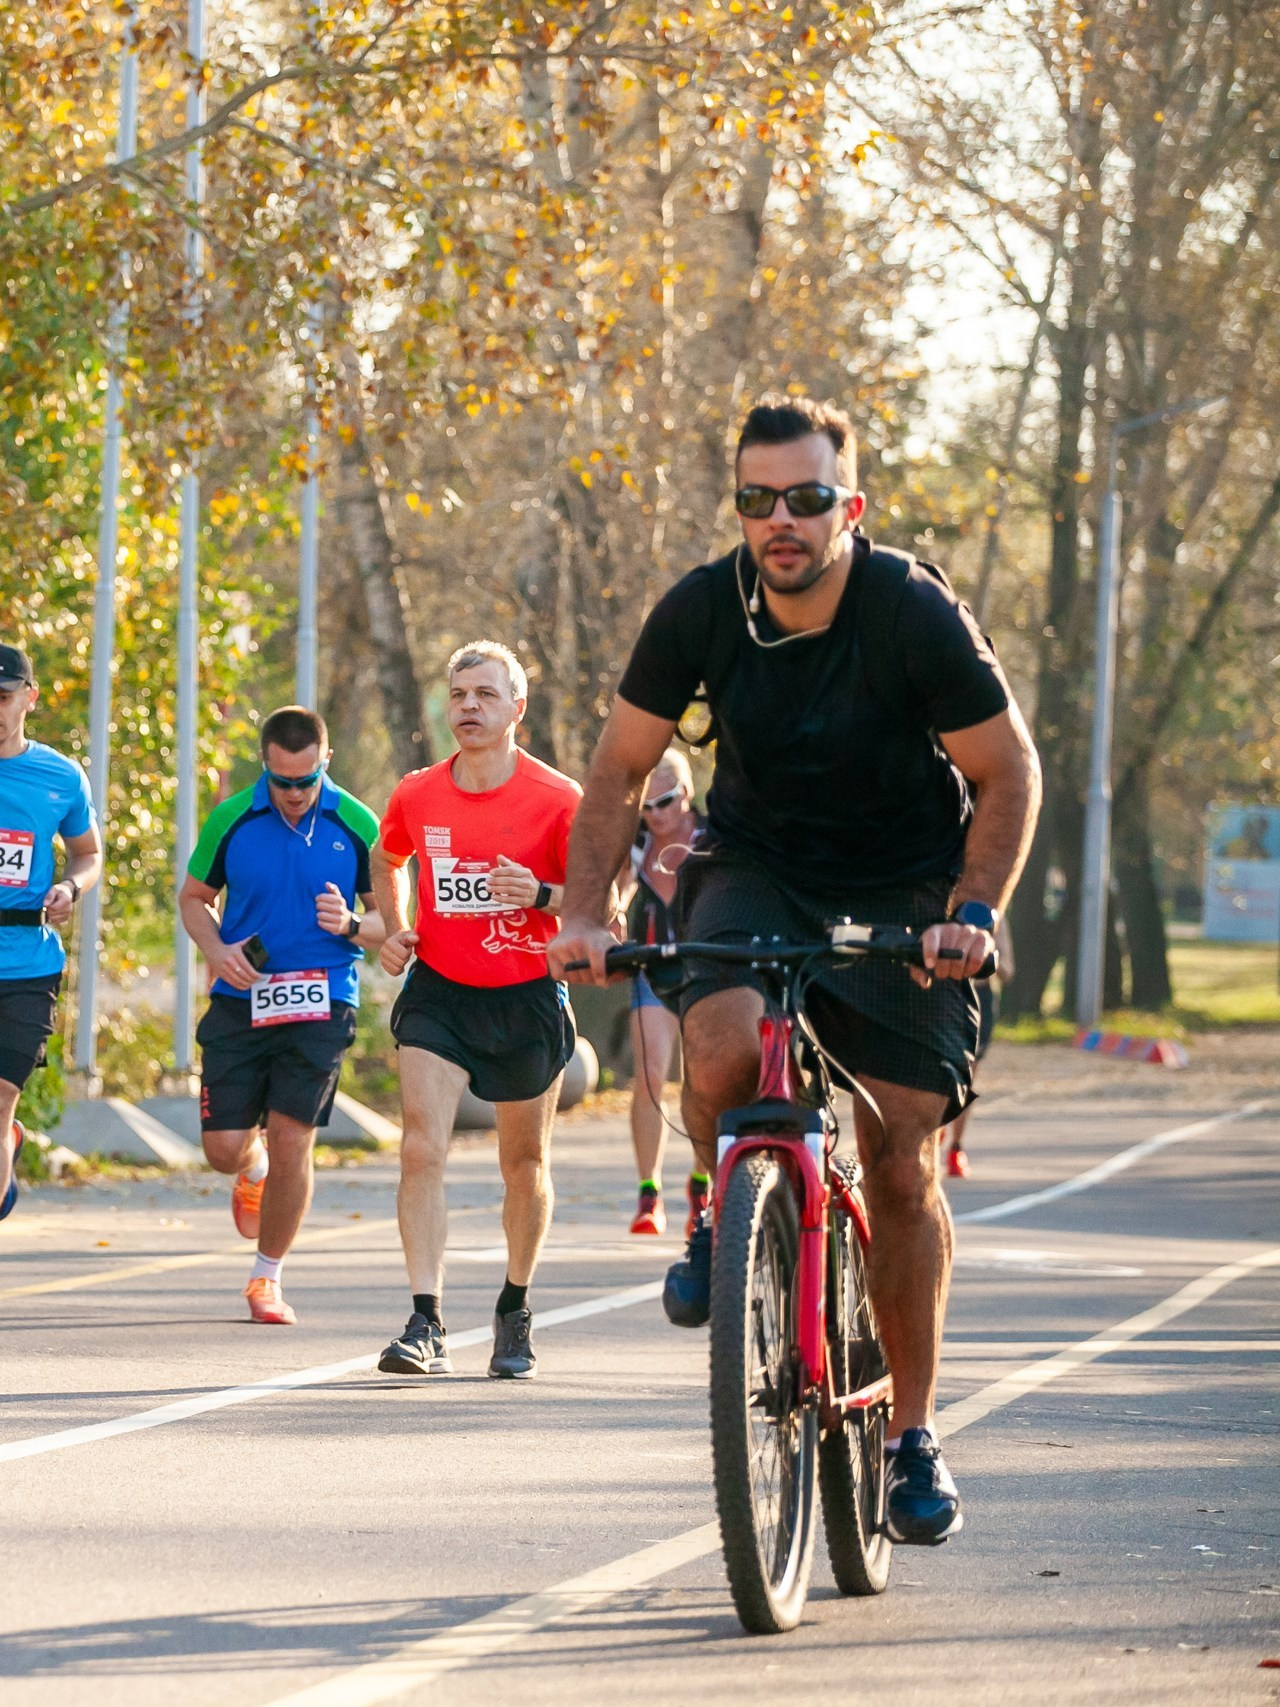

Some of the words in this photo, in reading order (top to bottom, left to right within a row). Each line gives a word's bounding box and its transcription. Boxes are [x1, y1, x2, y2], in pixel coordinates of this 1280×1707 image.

[423, 826, 451, 835] TOMSK
[438, 877, 509, 902] 586
[257, 984, 324, 1010] 5656
